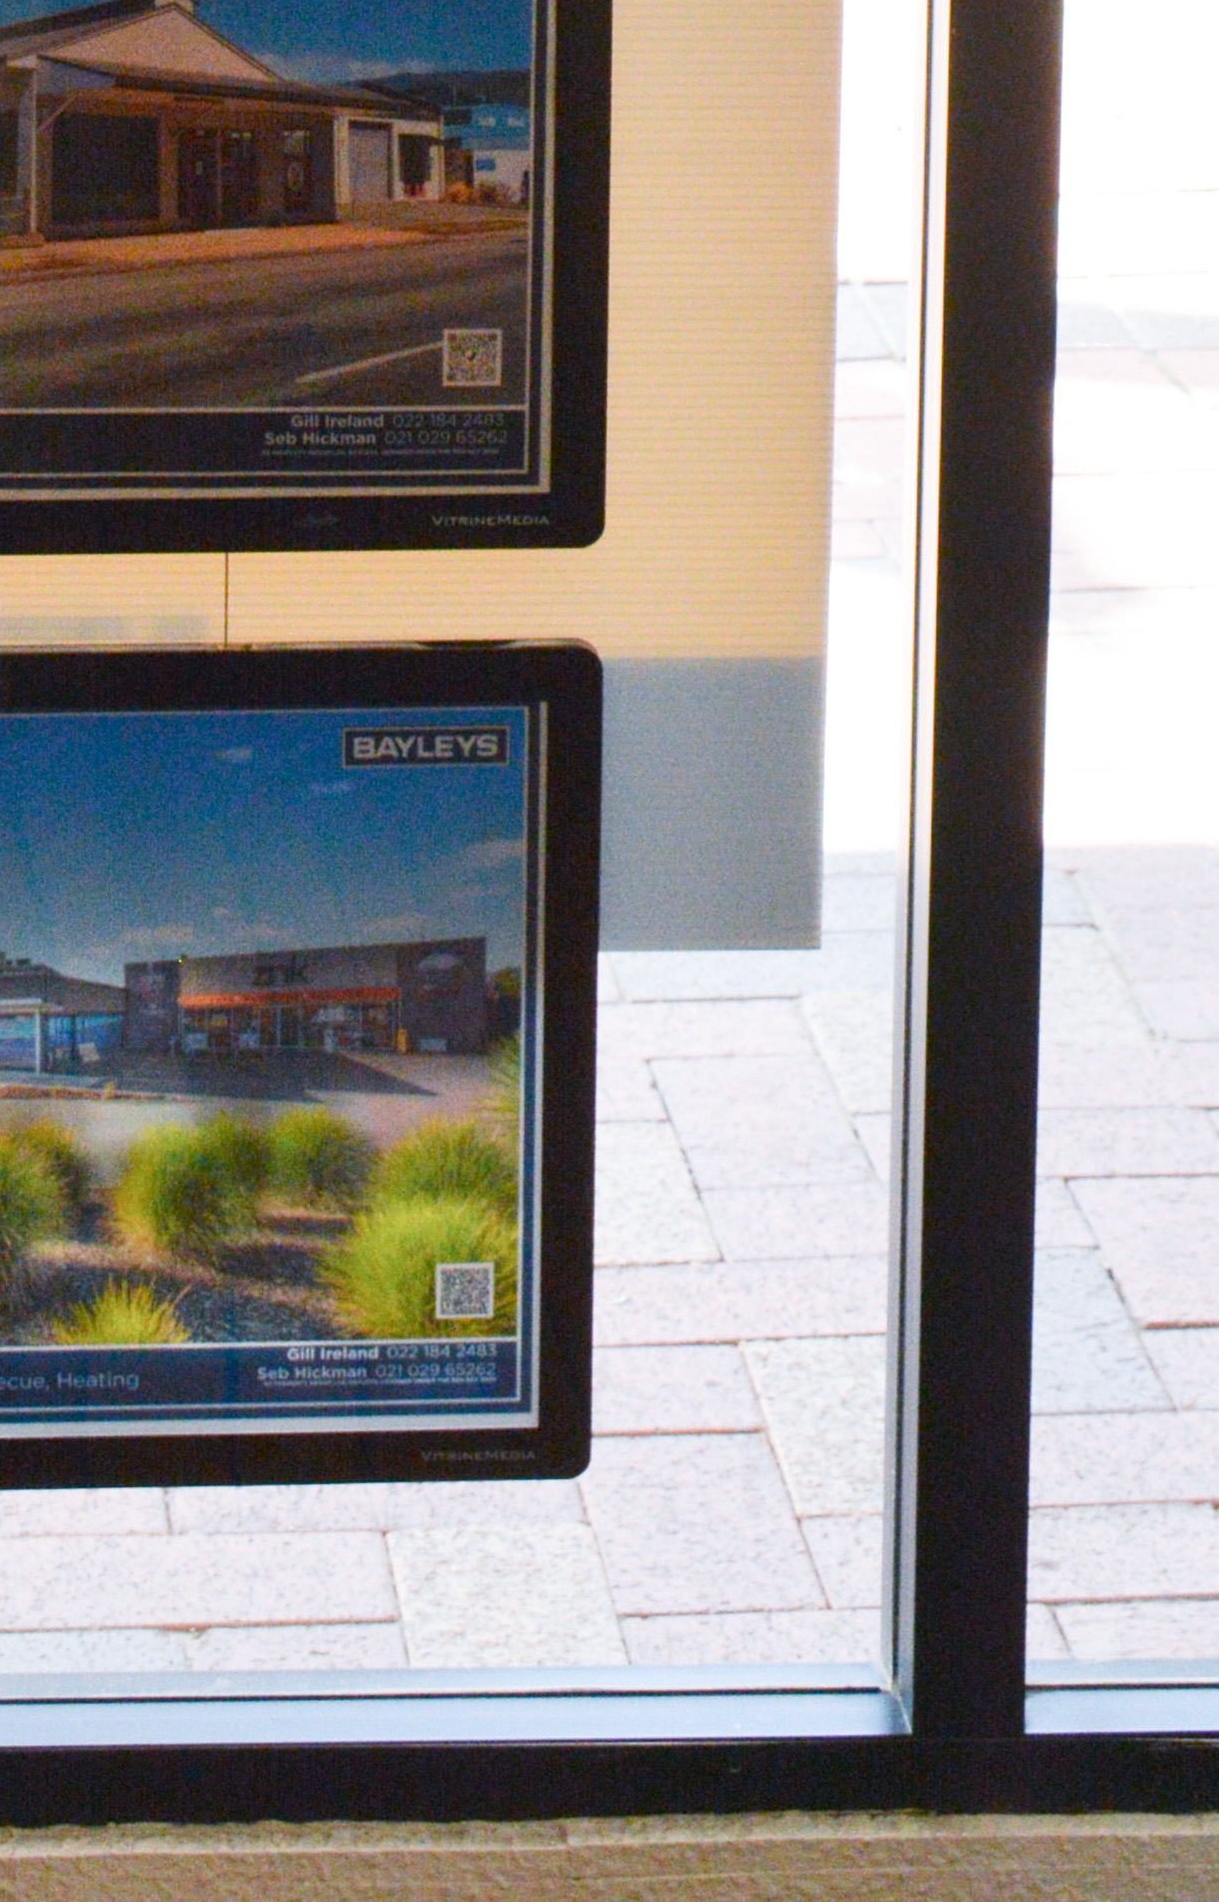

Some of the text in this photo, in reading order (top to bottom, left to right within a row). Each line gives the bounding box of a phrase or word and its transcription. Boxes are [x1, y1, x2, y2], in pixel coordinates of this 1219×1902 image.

[291, 414, 319, 428] Gill
[325, 414, 384, 428] Ireland
[392, 413, 424, 427] 022
[463, 413, 505, 427] 2483
[264, 430, 508, 445] Seb Hickman 021 029 65262
[353, 734, 498, 759] BAYLEYS
[287, 1344, 498, 1361] Gill Ireland 022 184 2483
[57, 1370, 140, 1391] Heating
[257, 1363, 496, 1381] Seb Hickman 021 029 65262
